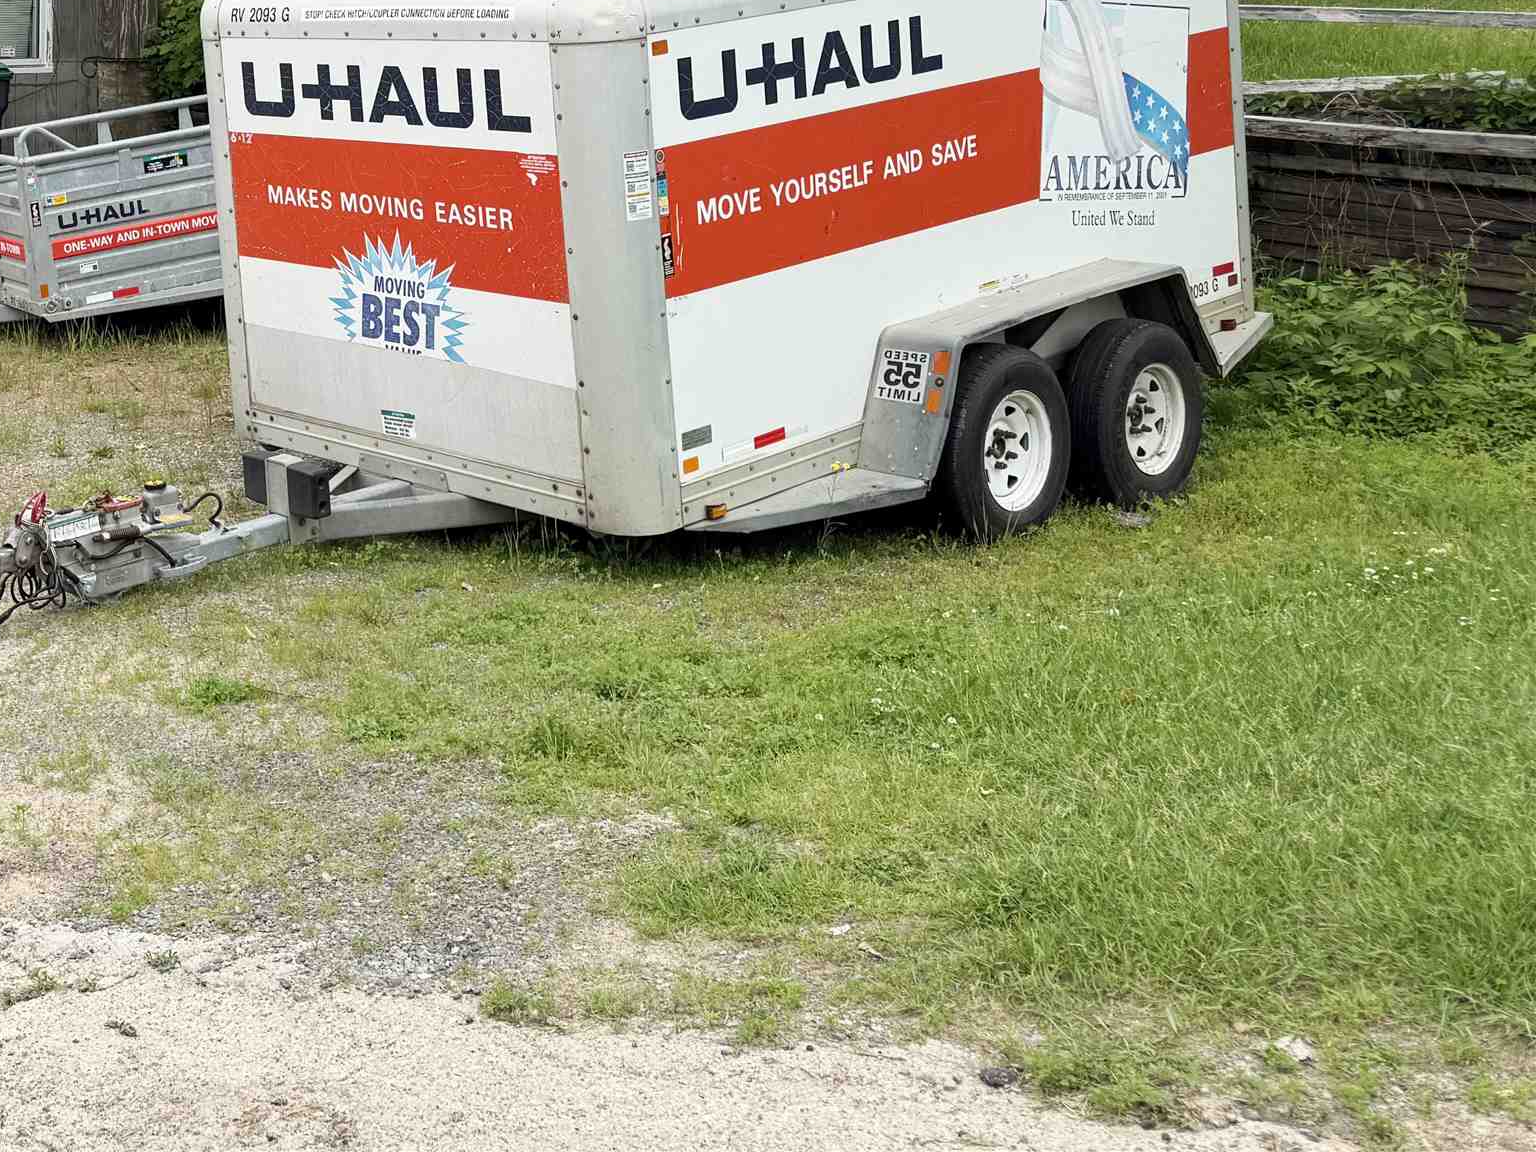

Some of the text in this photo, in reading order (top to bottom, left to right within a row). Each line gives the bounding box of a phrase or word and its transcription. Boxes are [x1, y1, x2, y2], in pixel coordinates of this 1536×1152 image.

[231, 7, 290, 22] RV 2093 G
[325, 10, 346, 19] CHECK
[400, 8, 445, 18] CONNECTION
[446, 8, 475, 19] BEFORE
[476, 9, 509, 19] LOADING
[677, 15, 944, 121] U-HAUL
[240, 61, 533, 134] U-HAUL
[696, 134, 978, 225] MOVE YOURSELF AND SAVE
[1042, 154, 1182, 191] AMERICA
[57, 199, 151, 230] U-HAUL
[266, 184, 514, 231] MAKES MOVING EASIER
[1071, 210, 1156, 226] United We Stand
[64, 215, 218, 253] ONE-WAY AND IN-TOWN MOV
[374, 275, 425, 299] MOVING
[1190, 282, 1209, 298] 093
[361, 293, 441, 351] BEST
